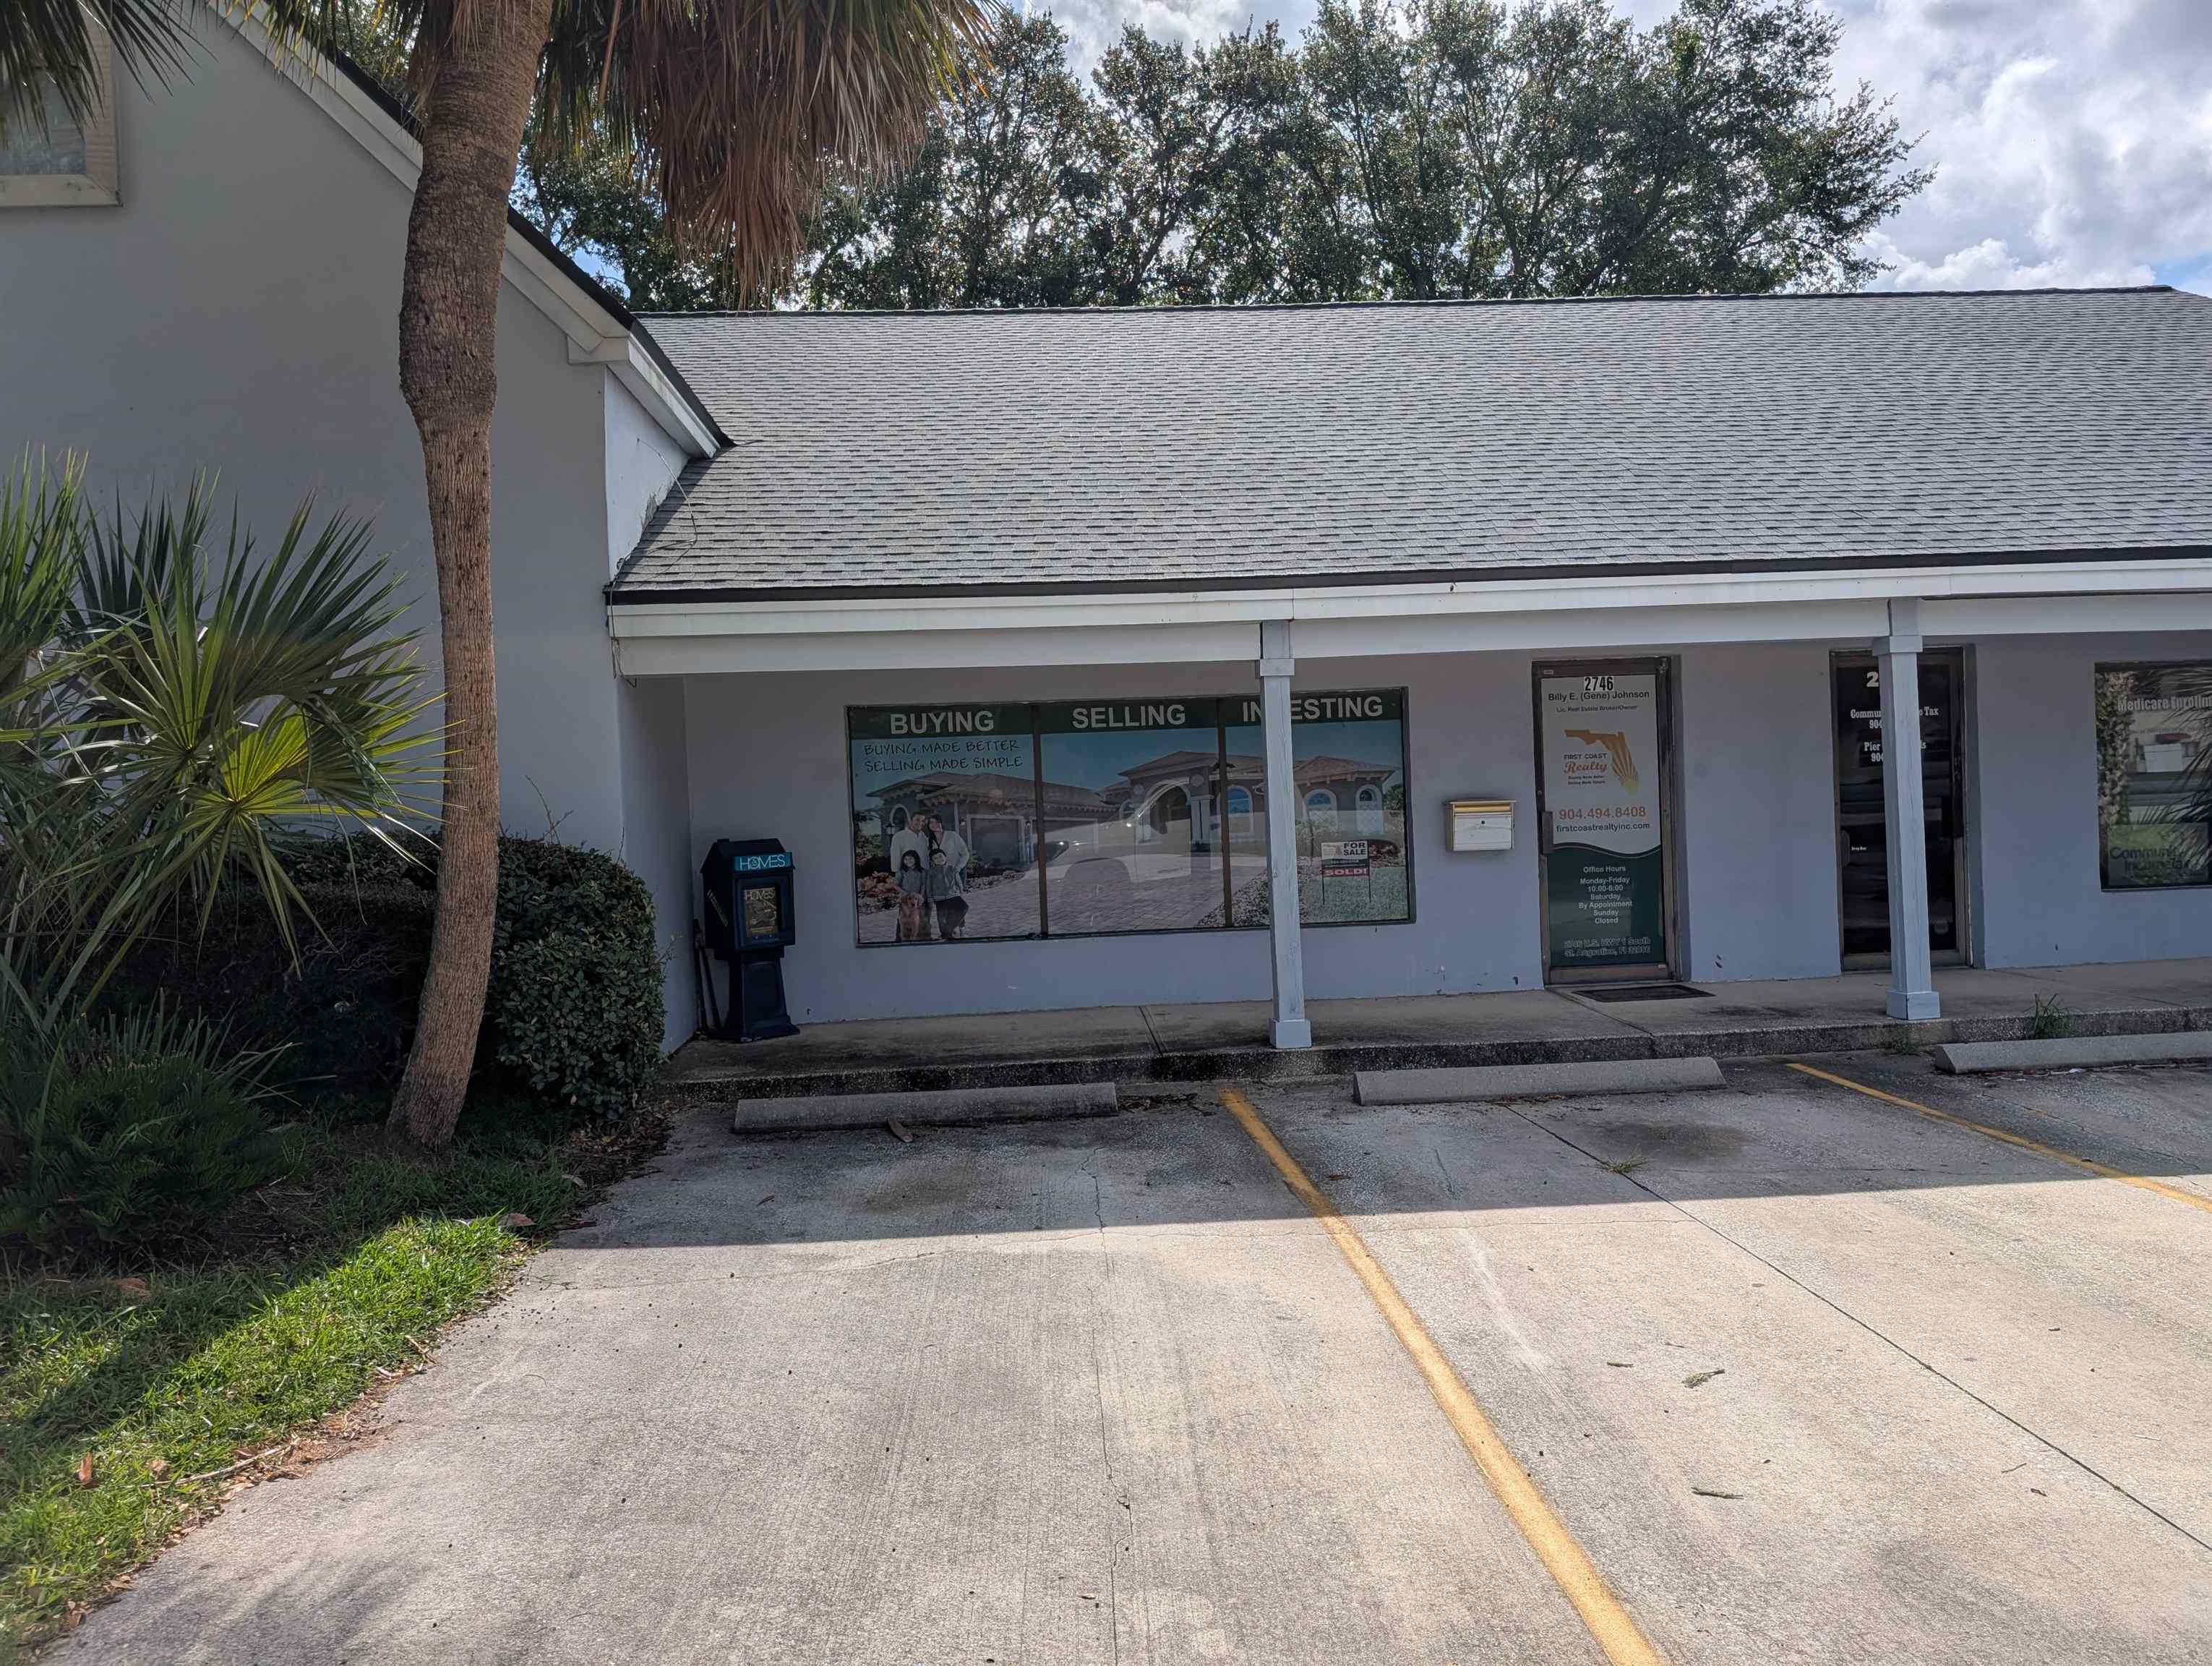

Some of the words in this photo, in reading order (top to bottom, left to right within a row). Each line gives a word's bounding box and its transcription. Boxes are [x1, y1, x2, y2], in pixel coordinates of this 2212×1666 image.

[1585, 676, 1614, 692] 2746
[1548, 693, 1568, 702] Billy
[1581, 691, 1611, 701] (Gene)
[1613, 691, 1650, 700] Johnson
[1243, 696, 1383, 723] INESTING
[2117, 696, 2169, 712] Medicare
[1071, 705, 1186, 730] SELLING
[1851, 709, 1882, 718] Commu
[1924, 706, 1939, 716] Tax
[890, 710, 995, 735] BUYING
[865, 743, 917, 756] BUYING
[920, 742, 961, 753] MADE
[966, 739, 1020, 752] BETTER
[1864, 742, 1881, 751] Pier
[865, 760, 925, 773] SELLING
[930, 758, 969, 769] MADE
[973, 756, 1024, 769] SIMPLE
[1564, 761, 1608, 774] Realty
[1559, 806, 1647, 820] 904.494.8408
[1556, 823, 1651, 832] firstcoastrealtyinc.com
[740, 854, 786, 871] HOMES
[1324, 868, 1368, 876] SOLD!
[1579, 876, 1631, 885] Monday-Friday
[1590, 901, 1633, 910] Appointment
